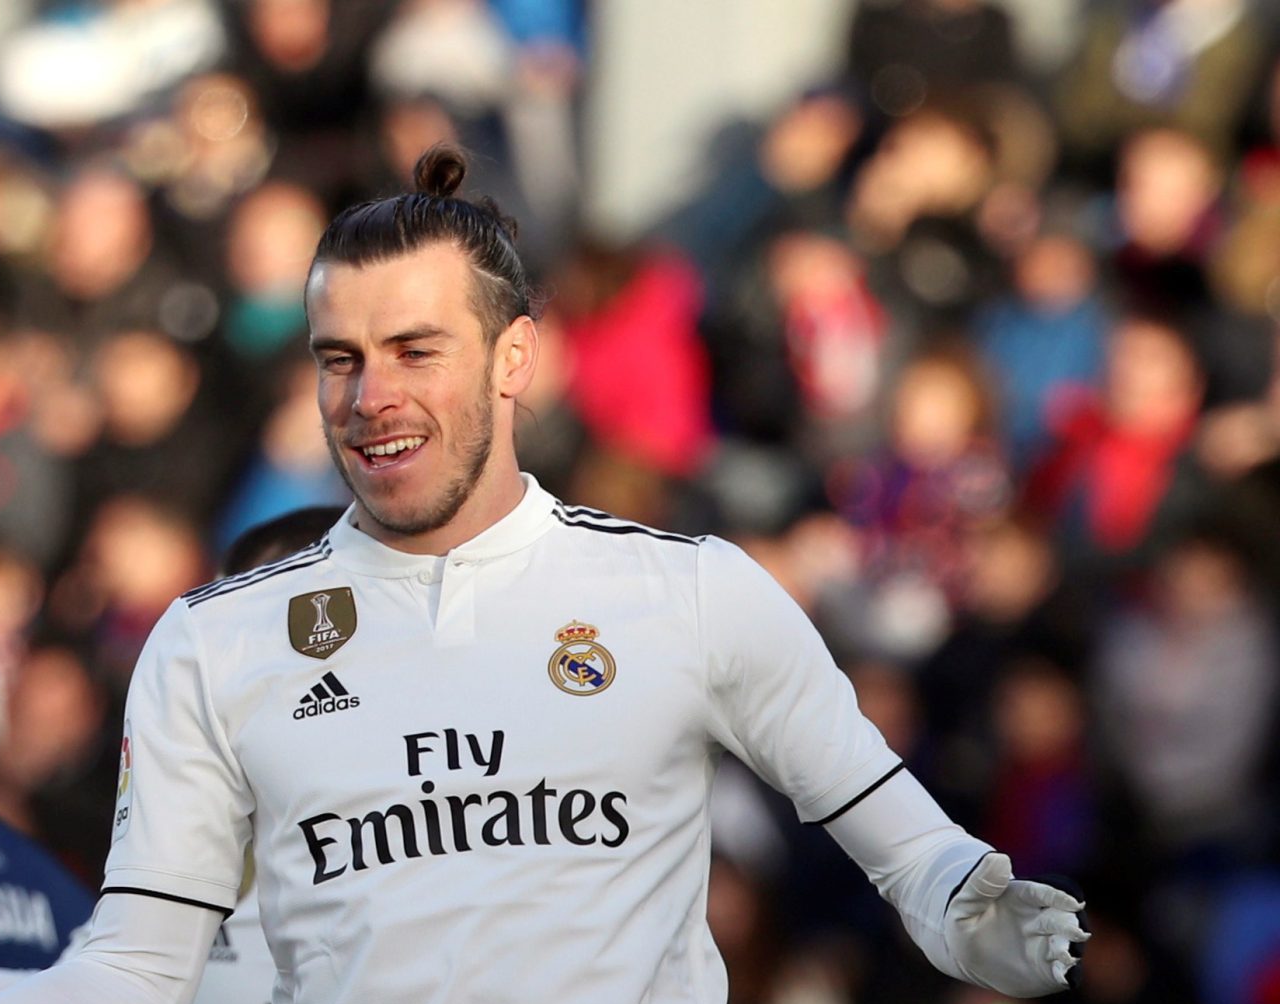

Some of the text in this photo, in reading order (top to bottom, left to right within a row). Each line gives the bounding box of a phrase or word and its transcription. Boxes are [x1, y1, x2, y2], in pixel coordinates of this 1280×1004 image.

[308, 630, 339, 645] FIFA
[293, 696, 360, 720] adidas
[403, 728, 505, 777] Fly
[297, 779, 630, 885] Emirates
